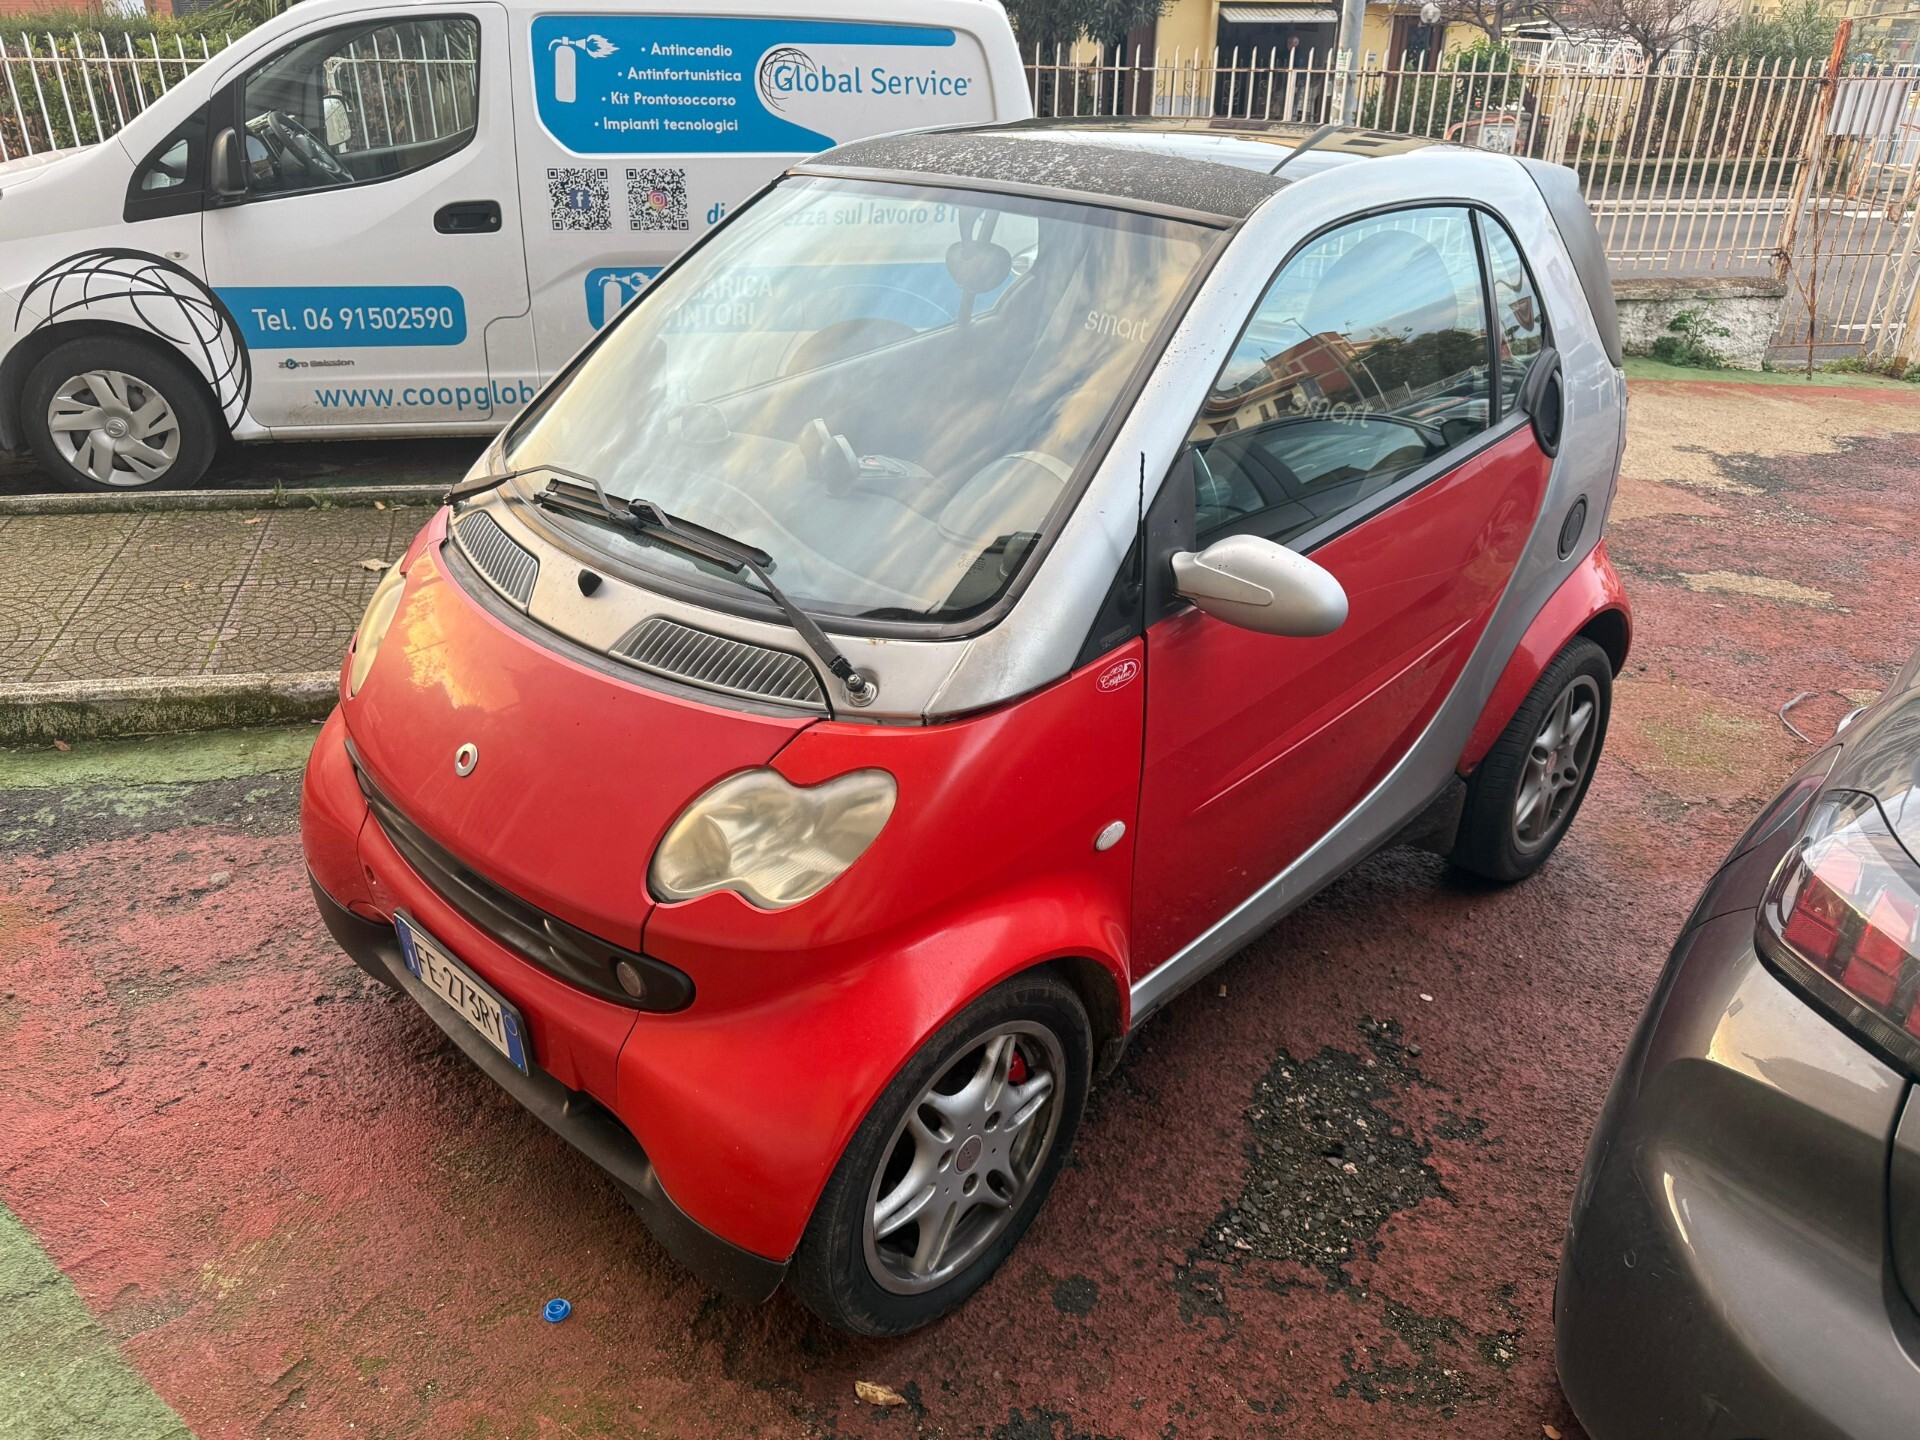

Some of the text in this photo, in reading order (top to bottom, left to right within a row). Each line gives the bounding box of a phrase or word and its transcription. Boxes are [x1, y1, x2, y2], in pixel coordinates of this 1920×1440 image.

[650, 42, 733, 57] Antincendio
[627, 66, 742, 82] Antinfortunistica
[774, 65, 968, 97] Global Service
[610, 91, 737, 106] Kit Prontosoccorso
[603, 116, 739, 134] Impianti tecnologici
[833, 202, 862, 225] sul
[868, 201, 928, 225] lavoro
[252, 306, 454, 331] Tel. 06 91502590
[1084, 310, 1150, 343] smart
[315, 380, 537, 411] www.coopglob
[1287, 394, 1374, 429] smart
